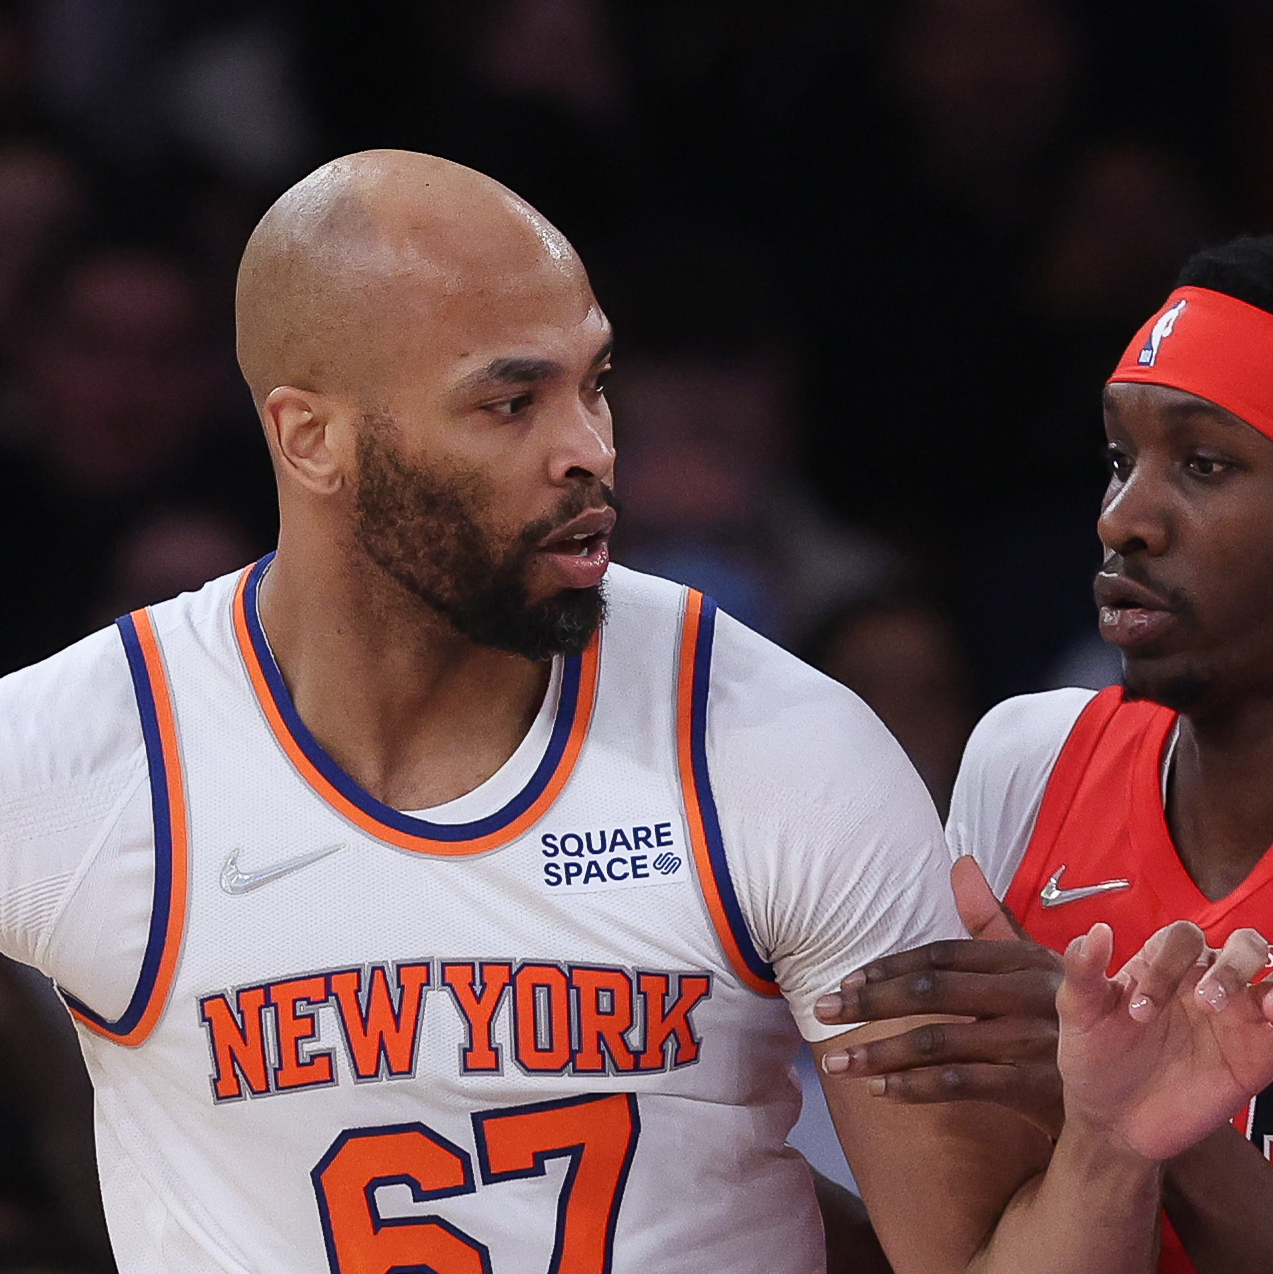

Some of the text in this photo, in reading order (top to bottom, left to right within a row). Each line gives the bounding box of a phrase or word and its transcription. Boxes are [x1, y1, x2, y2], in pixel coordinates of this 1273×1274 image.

[541, 822, 674, 858] SQUARE
[543, 855, 650, 887] SPACE
[197, 957, 715, 1105] NEW YORK
